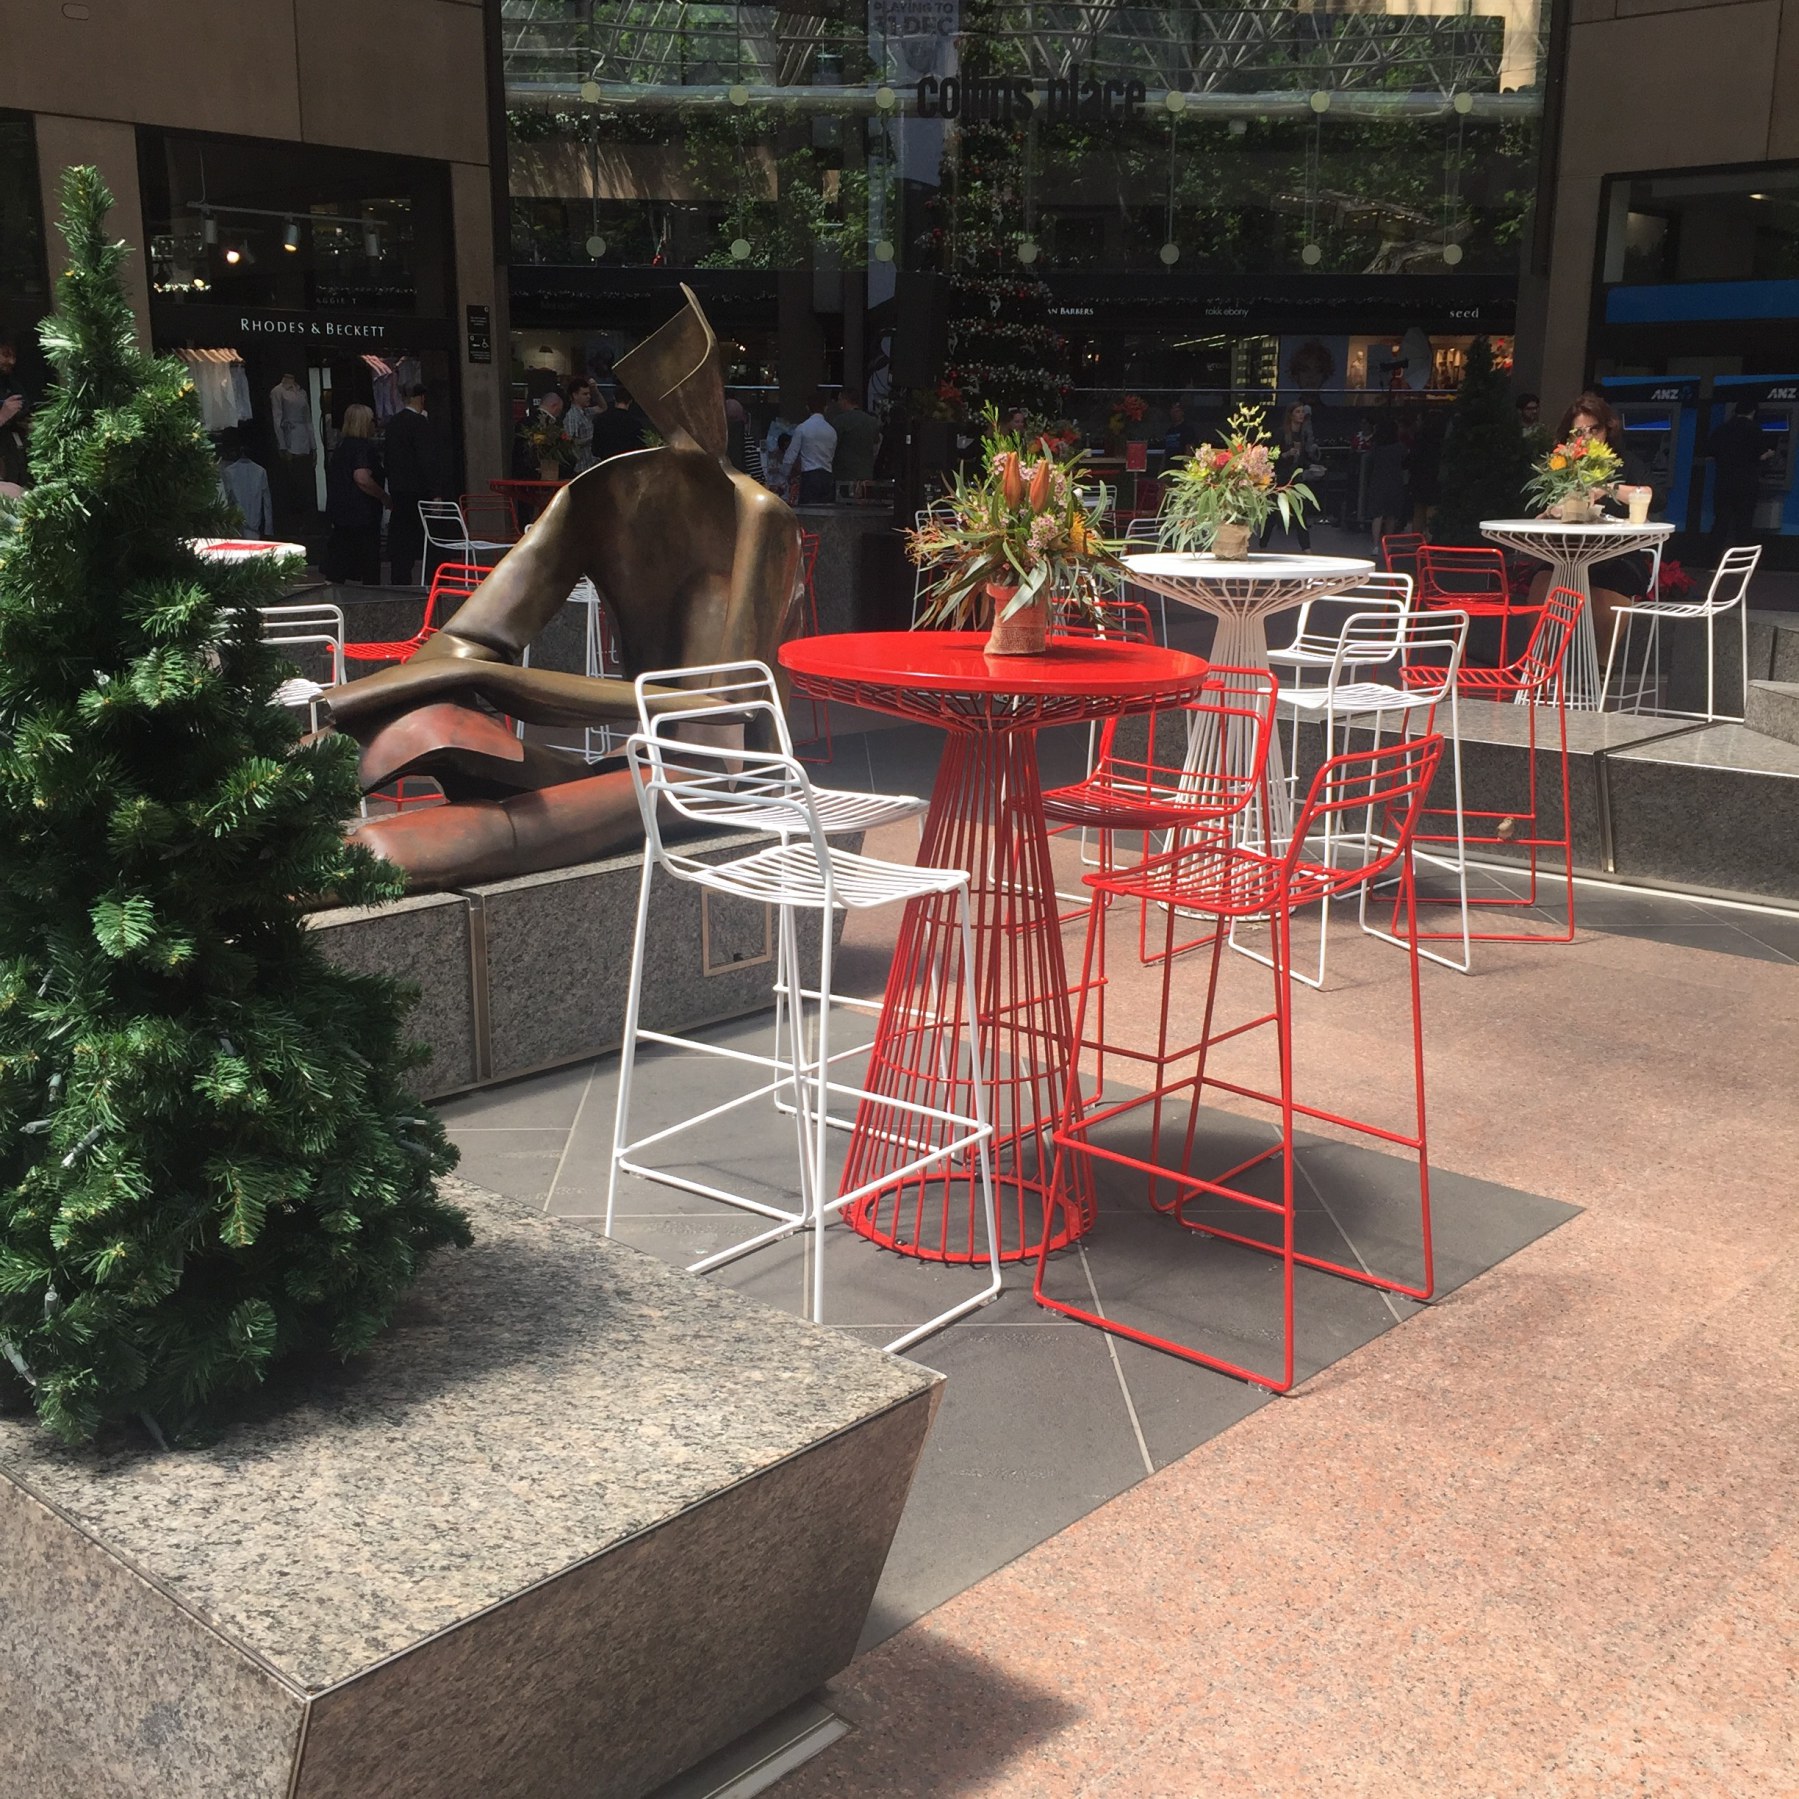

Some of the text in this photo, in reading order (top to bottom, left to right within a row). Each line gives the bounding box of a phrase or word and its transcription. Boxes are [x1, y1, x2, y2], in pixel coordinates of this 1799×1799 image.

[934, 2, 954, 14] TO
[903, 15, 954, 36] DEC
[1047, 63, 1146, 123] place
[1060, 307, 1094, 315] BARBERS
[1449, 307, 1479, 319] seed
[240, 318, 385, 338] RHODES & BECKETT
[1651, 389, 1679, 400] ANZ
[1767, 387, 1798, 399] ANZ
